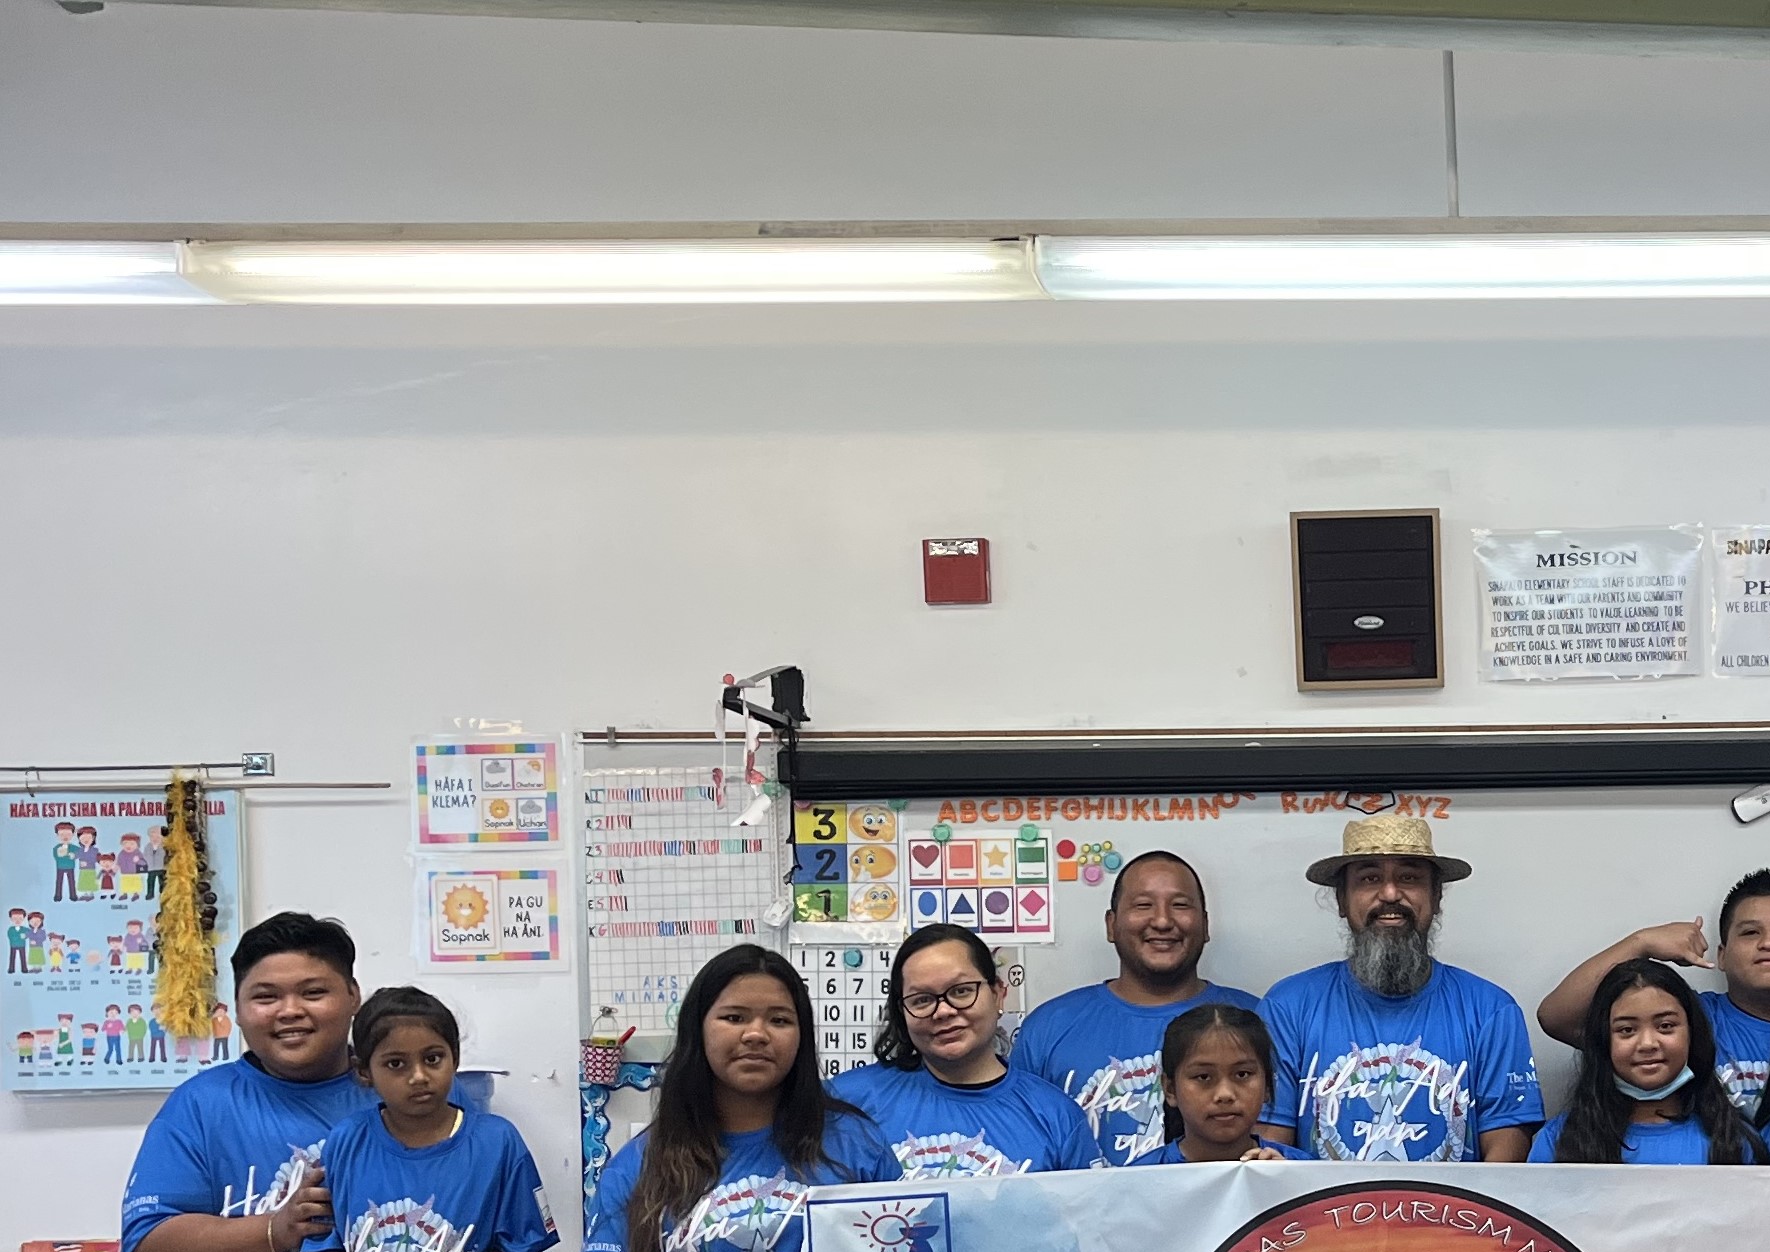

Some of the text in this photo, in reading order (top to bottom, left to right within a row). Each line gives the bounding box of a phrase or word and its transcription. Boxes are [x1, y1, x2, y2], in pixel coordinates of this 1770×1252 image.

[1536, 551, 1638, 568] MISSION
[1525, 578, 1569, 590] ELEMENTARY
[1602, 576, 1625, 587] STAFF
[1627, 576, 1634, 587] IS
[1677, 575, 1686, 586] TO
[1492, 595, 1513, 607] WORK
[1515, 595, 1526, 606] AS
[1536, 593, 1555, 605] TEAM
[1578, 592, 1591, 604] OUR
[1593, 592, 1625, 603] PARENTS
[1627, 591, 1641, 602] AND
[1492, 611, 1501, 622] TO
[1531, 609, 1545, 621] OUR
[1547, 608, 1584, 619] STUDENTS
[1588, 607, 1597, 618] TO
[1600, 606, 1623, 618] VALUE
[1625, 606, 1659, 617] LEARNING
[1664, 605, 1673, 616] TO
[1675, 605, 1683, 616] BE
[1725, 602, 1740, 613] WE
[1491, 620, 1685, 637] RESPECTFUL OF CULTURAL DIVERSITY AND CREATE AND
[1494, 635, 1688, 652] ACHIEVE GOALS. WE STRIVE TO INFUSE A LOVE OF
[1493, 650, 1689, 667] KNOWLEDGE IN A SAFE AND CARING ENVIRONMENT.
[1721, 655, 1733, 668] ALL
[1737, 654, 1769, 667] CHILDREN
[42, 802, 66, 817] ESTI
[100, 802, 115, 817] NA
[432, 795, 477, 808] KLEMA?
[813, 808, 837, 840] 3
[815, 849, 840, 881] 2
[515, 911, 531, 923] NA
[442, 929, 490, 945] Sopnak
[801, 951, 890, 967] 1 2 4
[826, 978, 837, 994] 6
[852, 978, 864, 994] 7
[824, 1005, 864, 1021] 10 11
[824, 1033, 867, 1049] 14 15
[825, 1059, 840, 1076] 18
[1324, 1200, 1513, 1247] TOURISM
